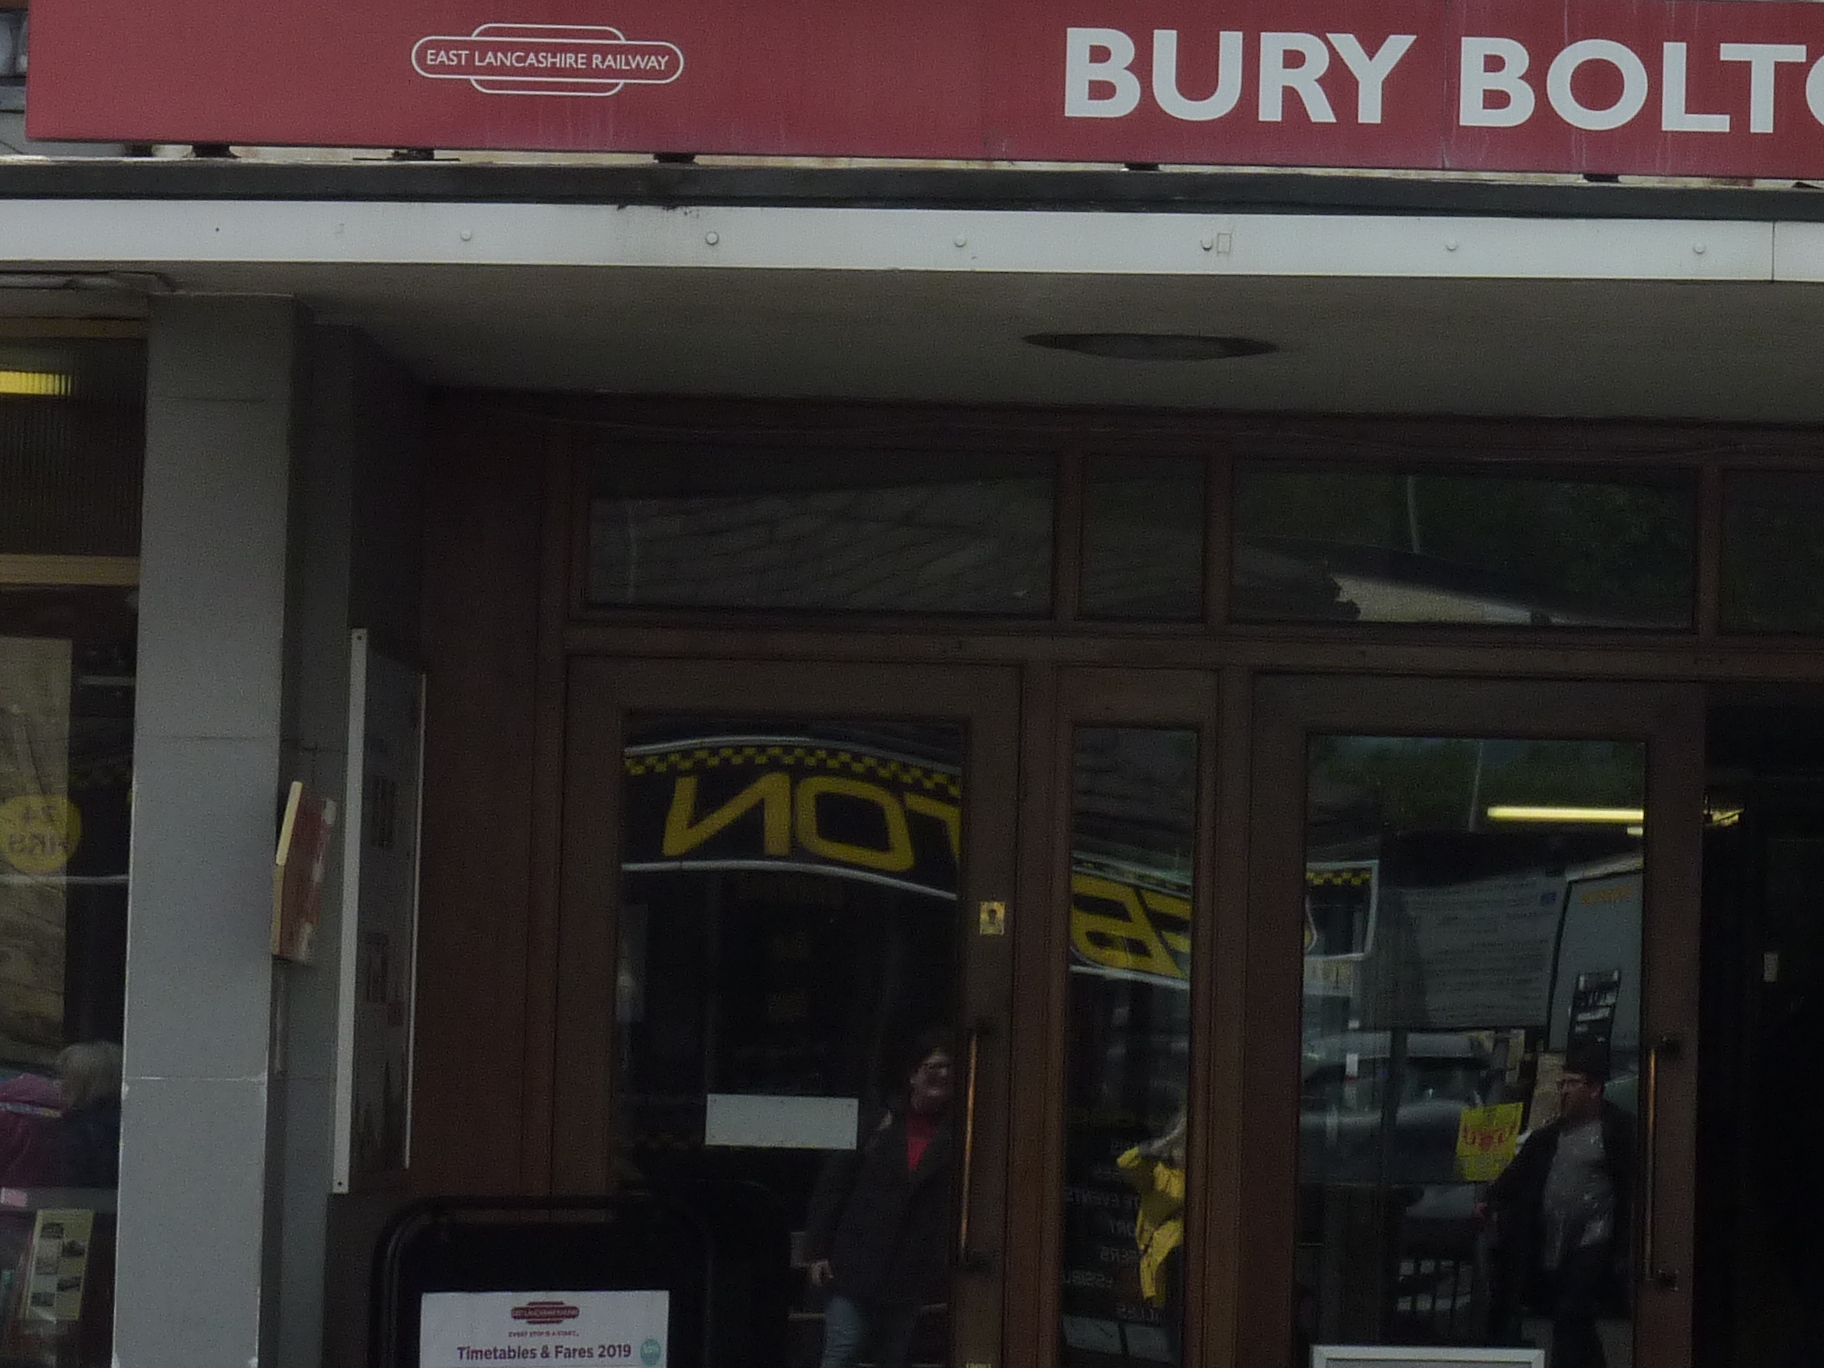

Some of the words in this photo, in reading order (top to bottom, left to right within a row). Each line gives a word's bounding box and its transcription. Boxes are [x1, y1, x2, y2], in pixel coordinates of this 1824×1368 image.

[426, 50, 470, 66] EAST
[474, 51, 588, 69] LANCASHIRE
[592, 54, 669, 70] RAILWAY
[1063, 27, 1418, 124] BURY
[456, 1345, 537, 1361] Timetables
[540, 1346, 551, 1359] &
[554, 1344, 594, 1360] Fares
[598, 1343, 632, 1359] 2019
